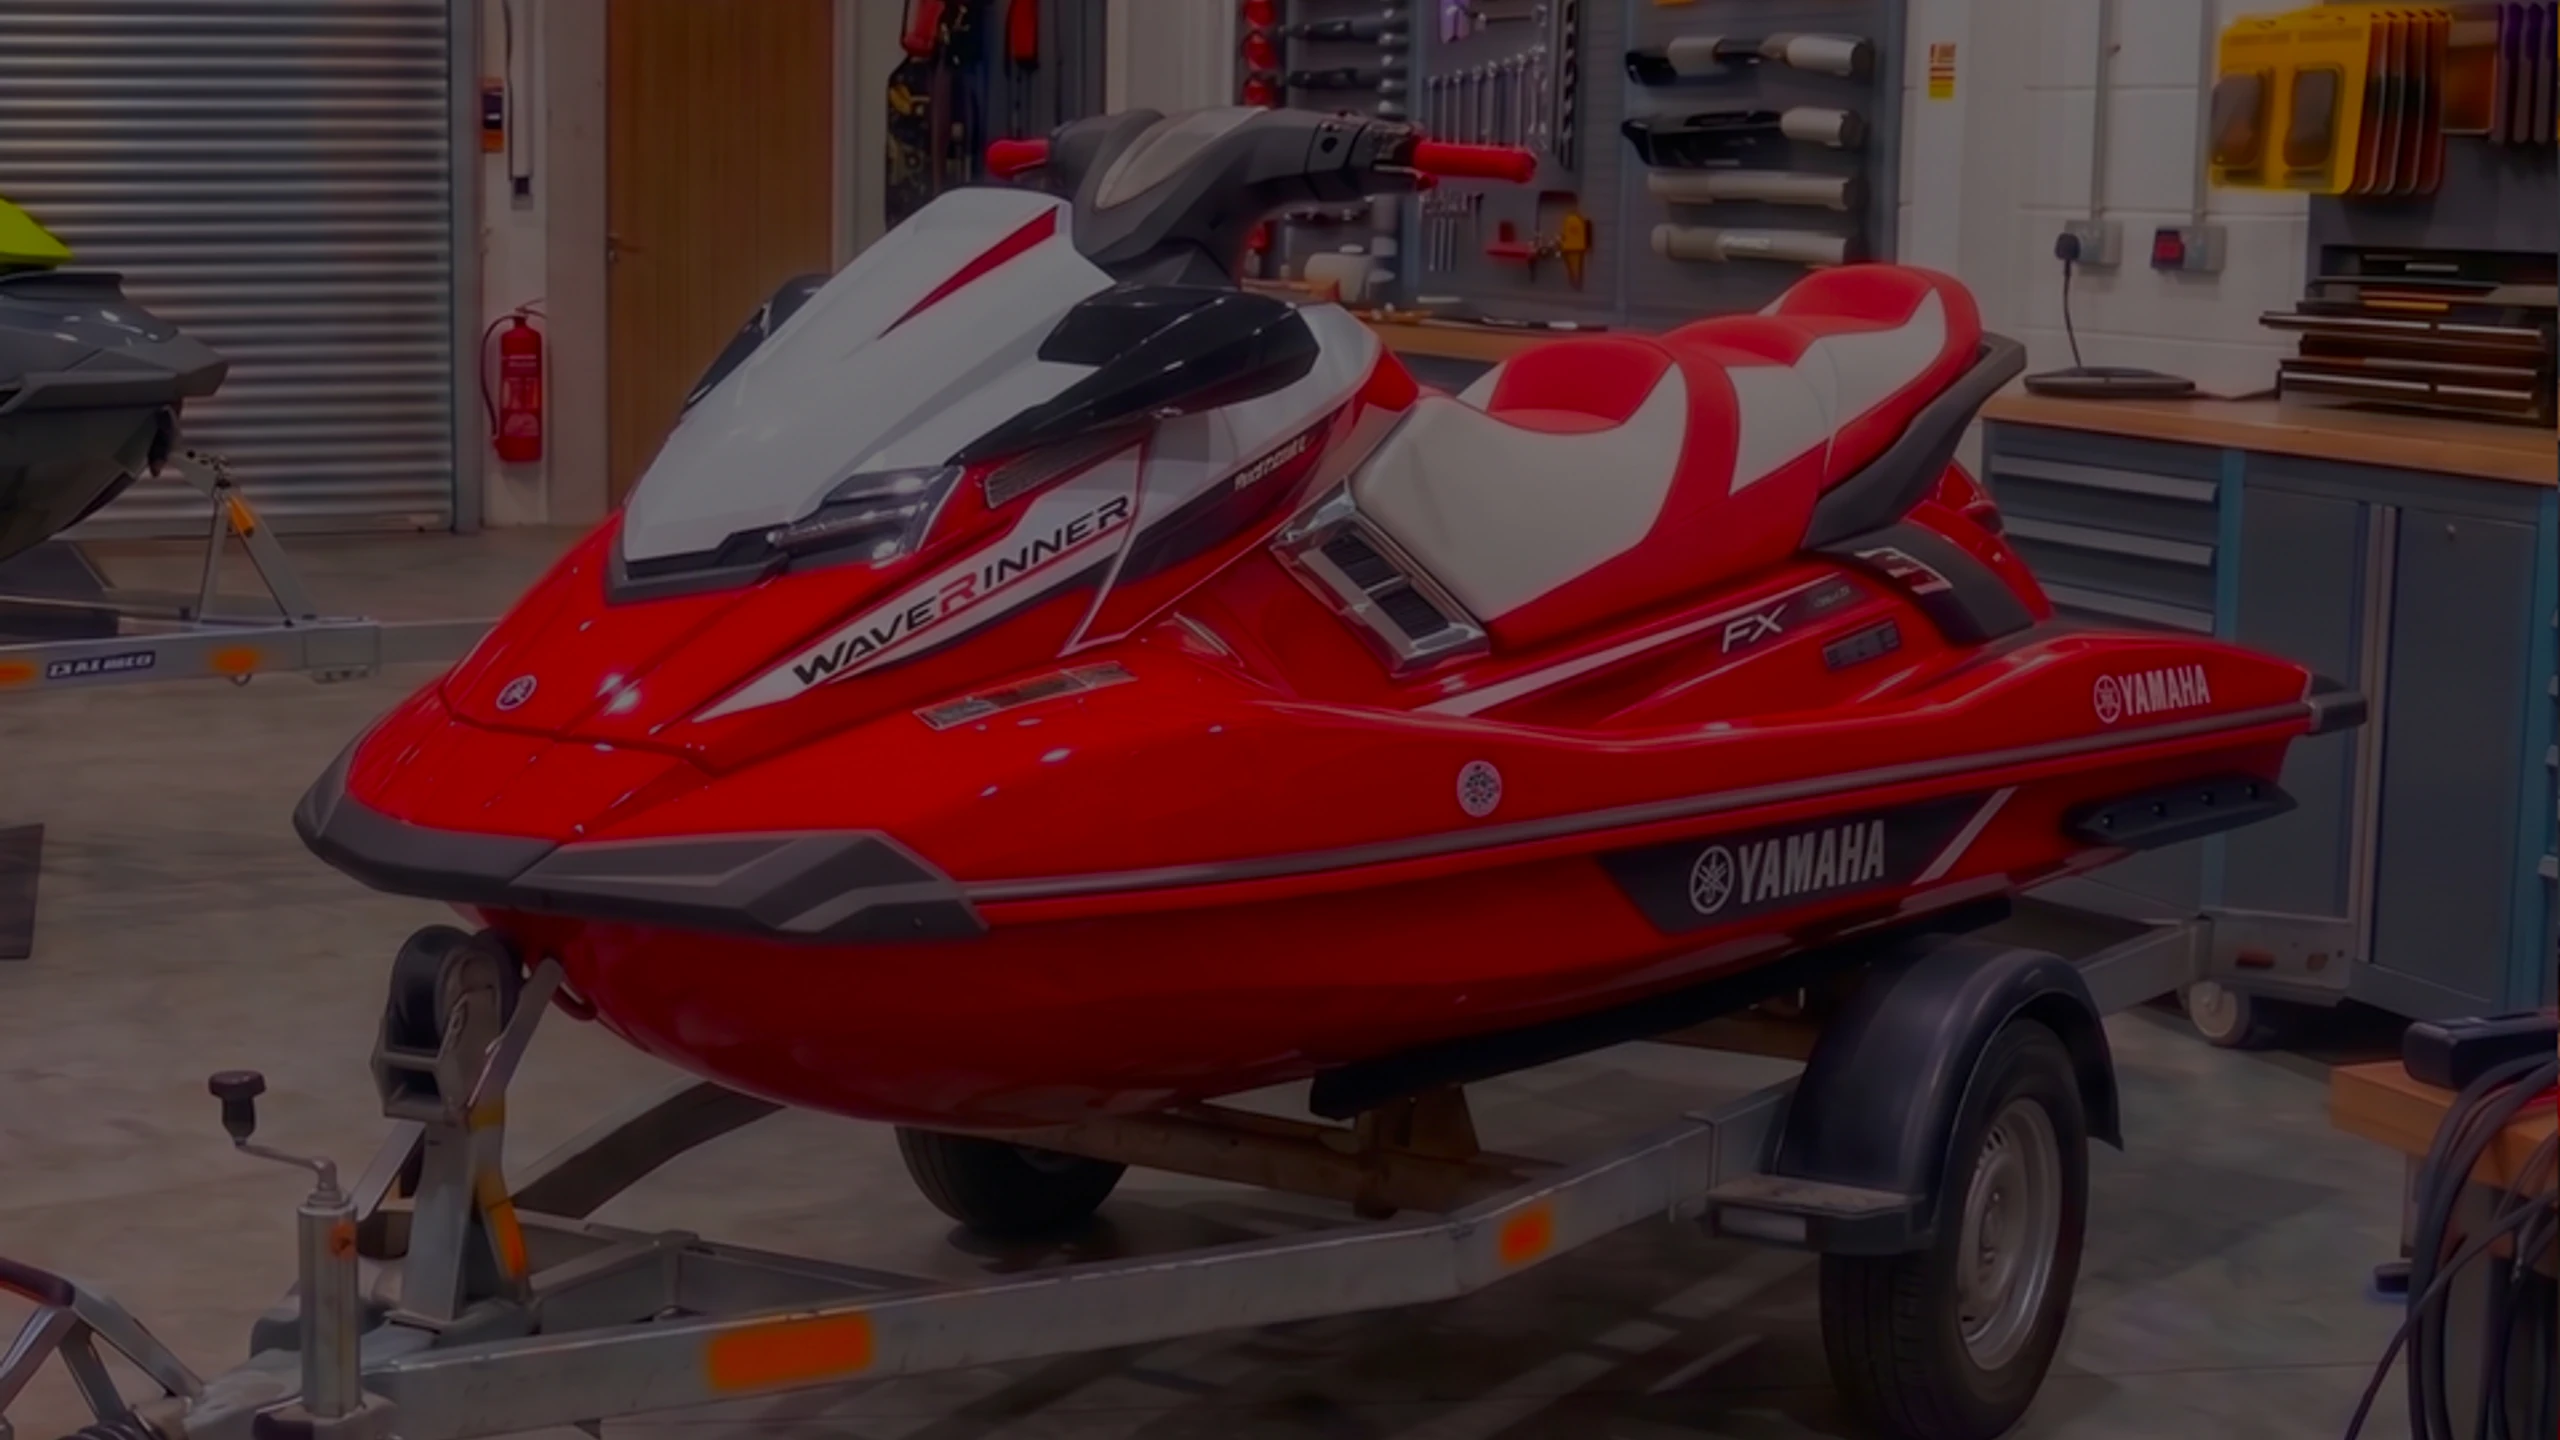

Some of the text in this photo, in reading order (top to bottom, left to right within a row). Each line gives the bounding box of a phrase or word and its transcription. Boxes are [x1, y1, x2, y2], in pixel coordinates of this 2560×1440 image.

[1721, 602, 1789, 654] FX
[2117, 664, 2212, 716] YAMAHA
[1738, 819, 1885, 904] YAMAHA
